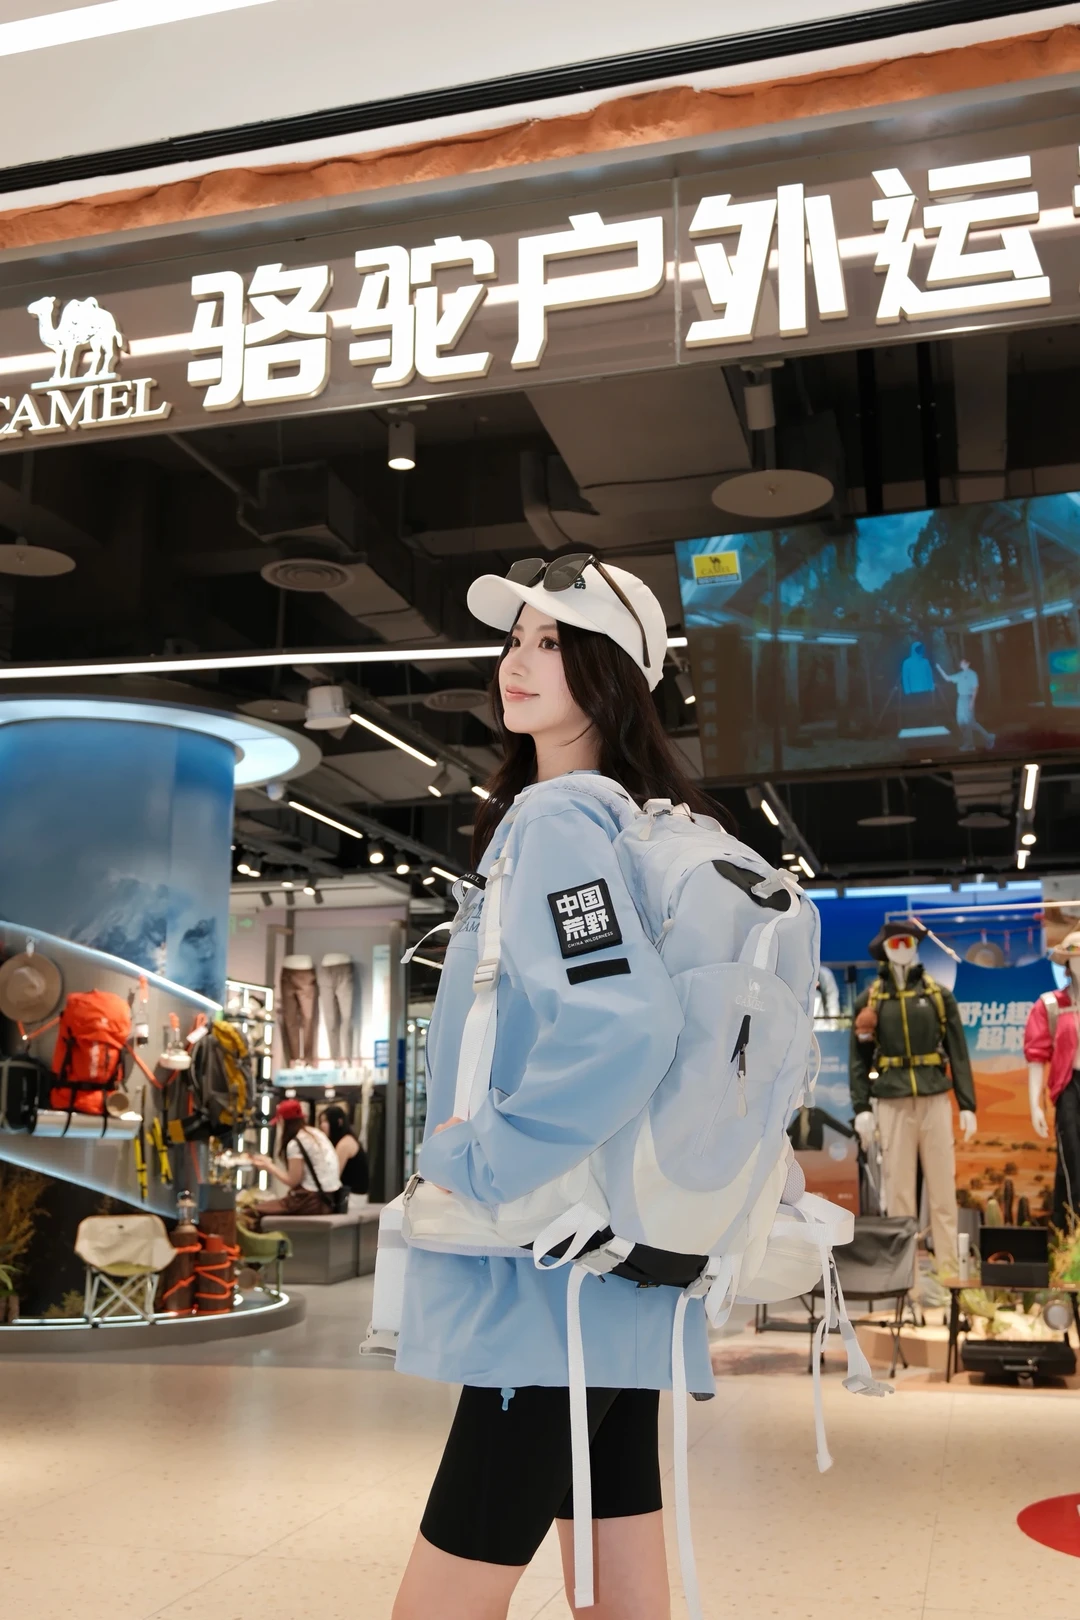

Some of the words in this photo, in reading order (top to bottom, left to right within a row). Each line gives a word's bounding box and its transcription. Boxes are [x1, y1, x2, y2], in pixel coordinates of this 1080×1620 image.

[187, 155, 1080, 411] 骆驼户外运
[556, 885, 605, 917] 中国
[562, 908, 610, 942] 荒野
[567, 940, 584, 949] CHINA
[584, 931, 614, 944] WILDERNESS
